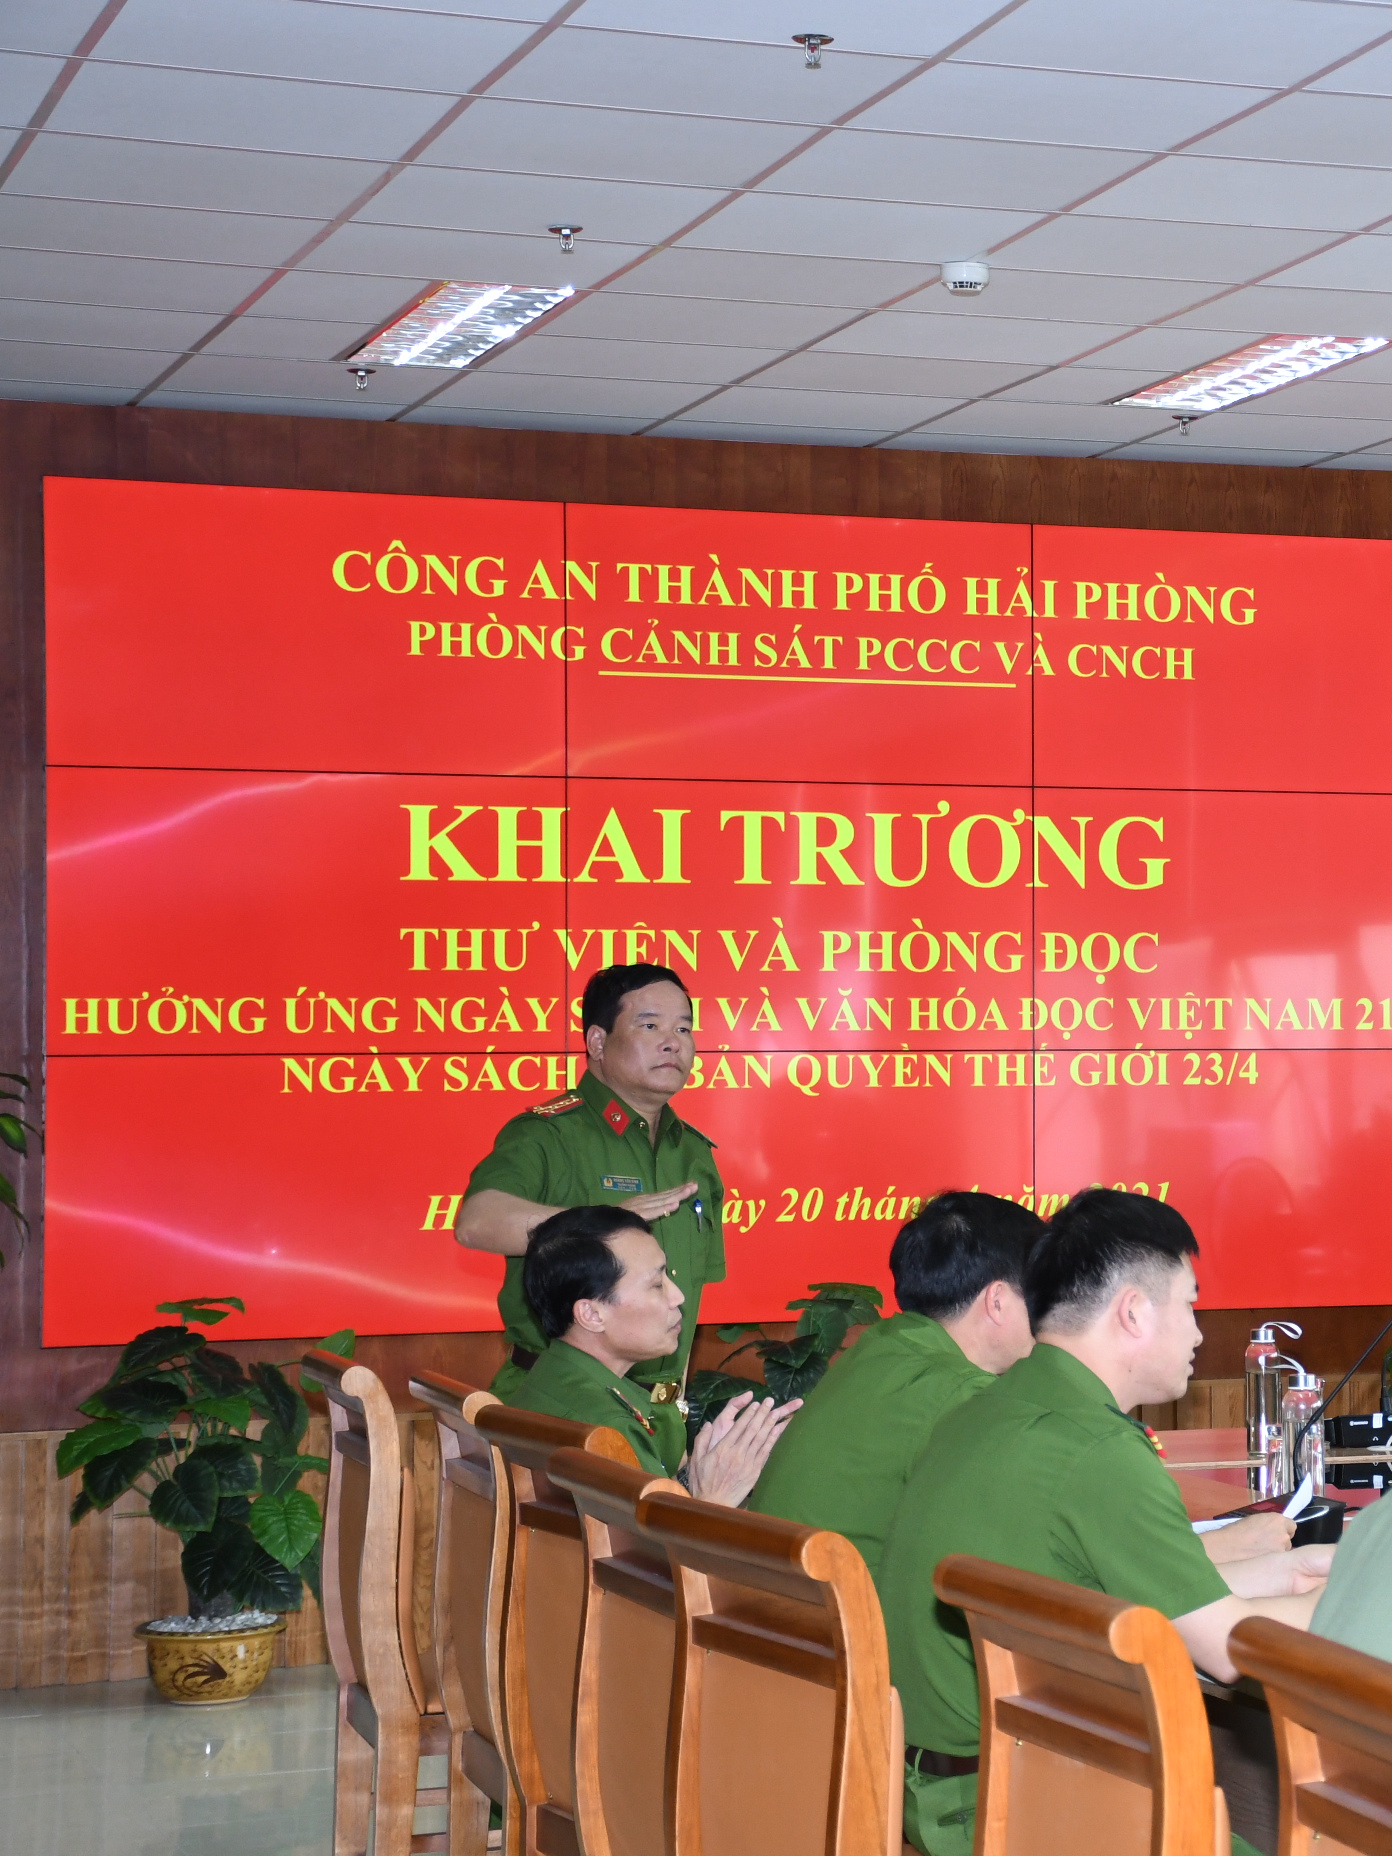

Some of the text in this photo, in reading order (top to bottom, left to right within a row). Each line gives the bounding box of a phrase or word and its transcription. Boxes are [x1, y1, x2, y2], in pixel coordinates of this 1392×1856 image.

[332, 539, 1258, 626] CÔNG AN THÀNH PHỐ HẢI PHÒNG
[407, 612, 1196, 681] PHÒNG CẢNH SÁT PCCC VÀ CNCH
[400, 800, 1172, 891] KHAI TRƯƠNG
[400, 921, 541, 972] THƯ
[718, 916, 801, 972] VÀ
[819, 918, 1025, 974] PHÒNG
[1041, 930, 1160, 985] ĐỌC
[61, 986, 267, 1035] HƯỞNG
[283, 986, 399, 1034] ỨNG
[414, 986, 560, 1033] NGÀY
[715, 986, 782, 1032] VÀ
[795, 987, 895, 1032] VĂN
[907, 986, 1009, 1032] HÓA
[1019, 997, 1115, 1040] ĐỌC
[1127, 991, 1234, 1040] VIỆT
[1244, 997, 1345, 1031] NAM
[281, 1042, 1260, 1097] NGÀY SÁCH BẢN QUYỀN THẾ GIỚI 23/4
[721, 1188, 767, 1234] ày
[775, 1186, 825, 1223] 20
[834, 1185, 936, 1222] thán
